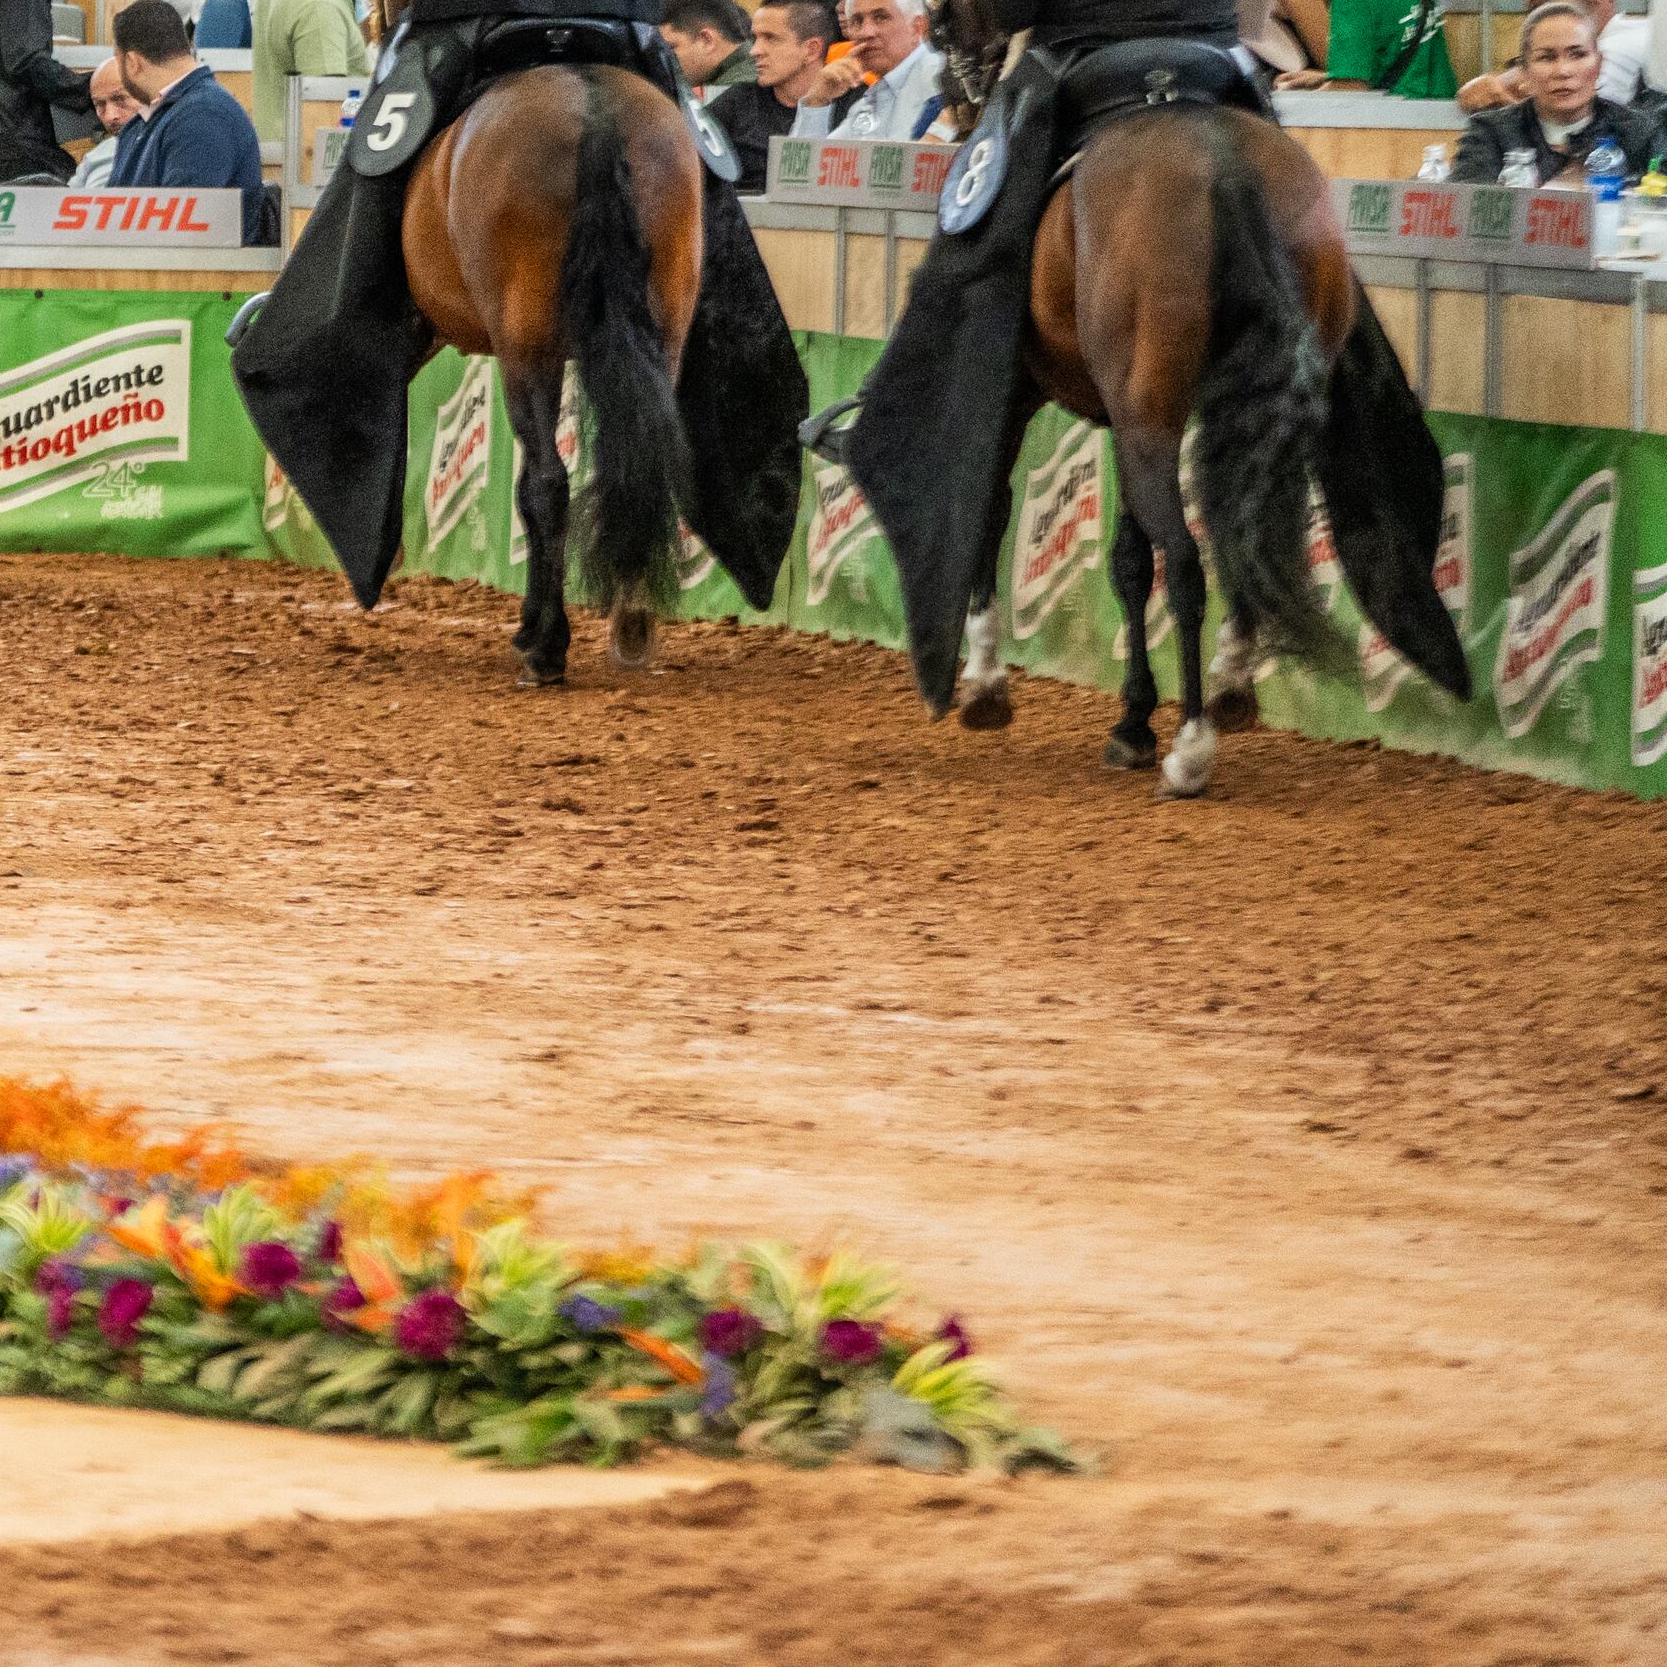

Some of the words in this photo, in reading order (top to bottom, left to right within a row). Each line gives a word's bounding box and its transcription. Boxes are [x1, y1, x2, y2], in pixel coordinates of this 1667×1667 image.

[367, 92, 417, 151] 5
[956, 137, 995, 207] 8
[52, 195, 210, 232] STIHL
